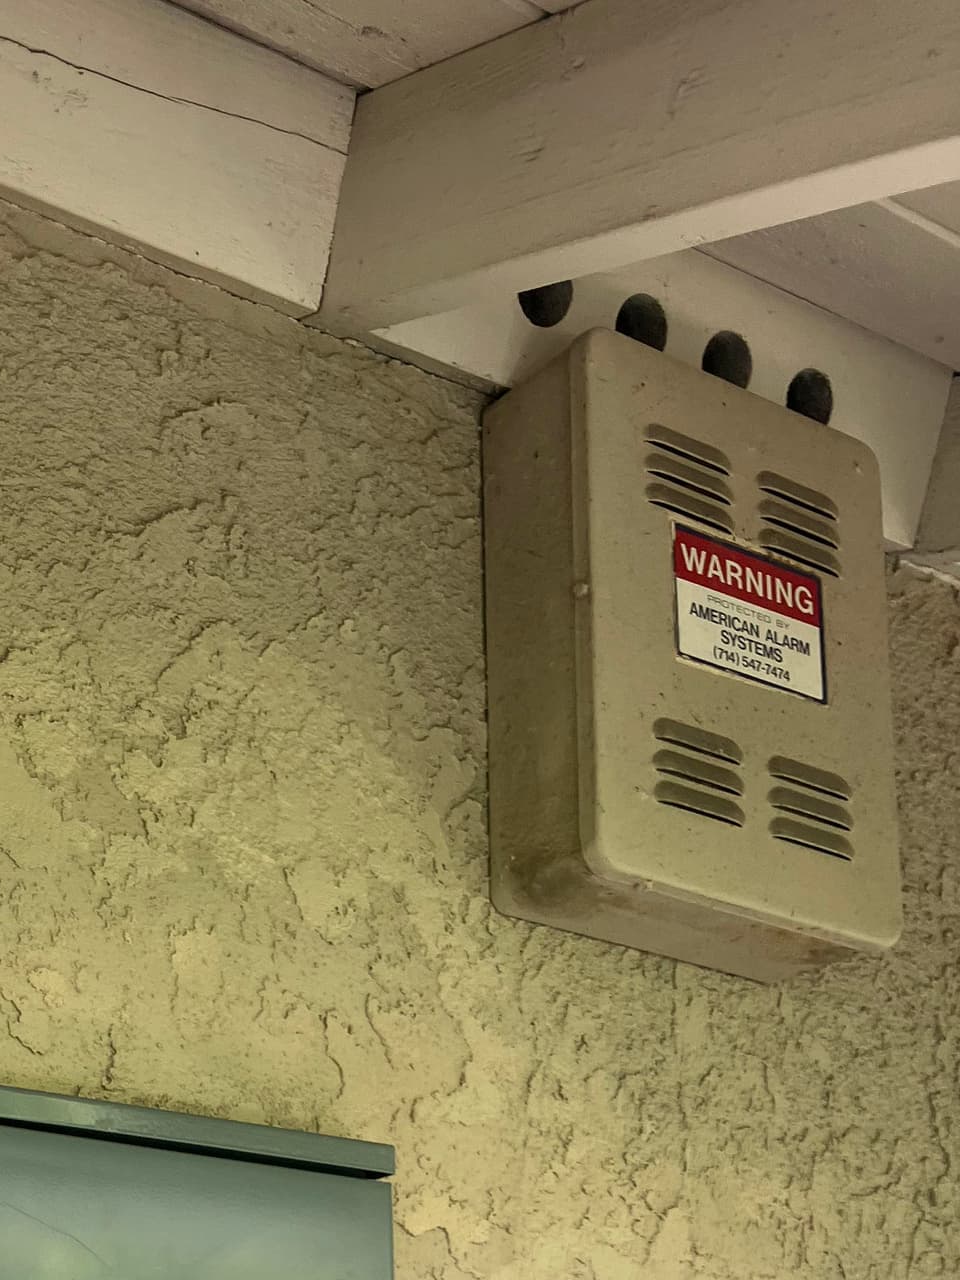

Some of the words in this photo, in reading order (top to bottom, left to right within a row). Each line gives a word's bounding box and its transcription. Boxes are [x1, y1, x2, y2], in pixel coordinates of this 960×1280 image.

[680, 543, 814, 615] WARNING
[689, 601, 760, 638] AMERICAN
[765, 629, 811, 656] ALARM
[707, 594, 771, 624] PROTECTED
[776, 619, 790, 628] BY
[713, 645, 740, 666] (714)
[741, 655, 791, 681] 547-7474
[720, 630, 783, 663] SYSTEMS
